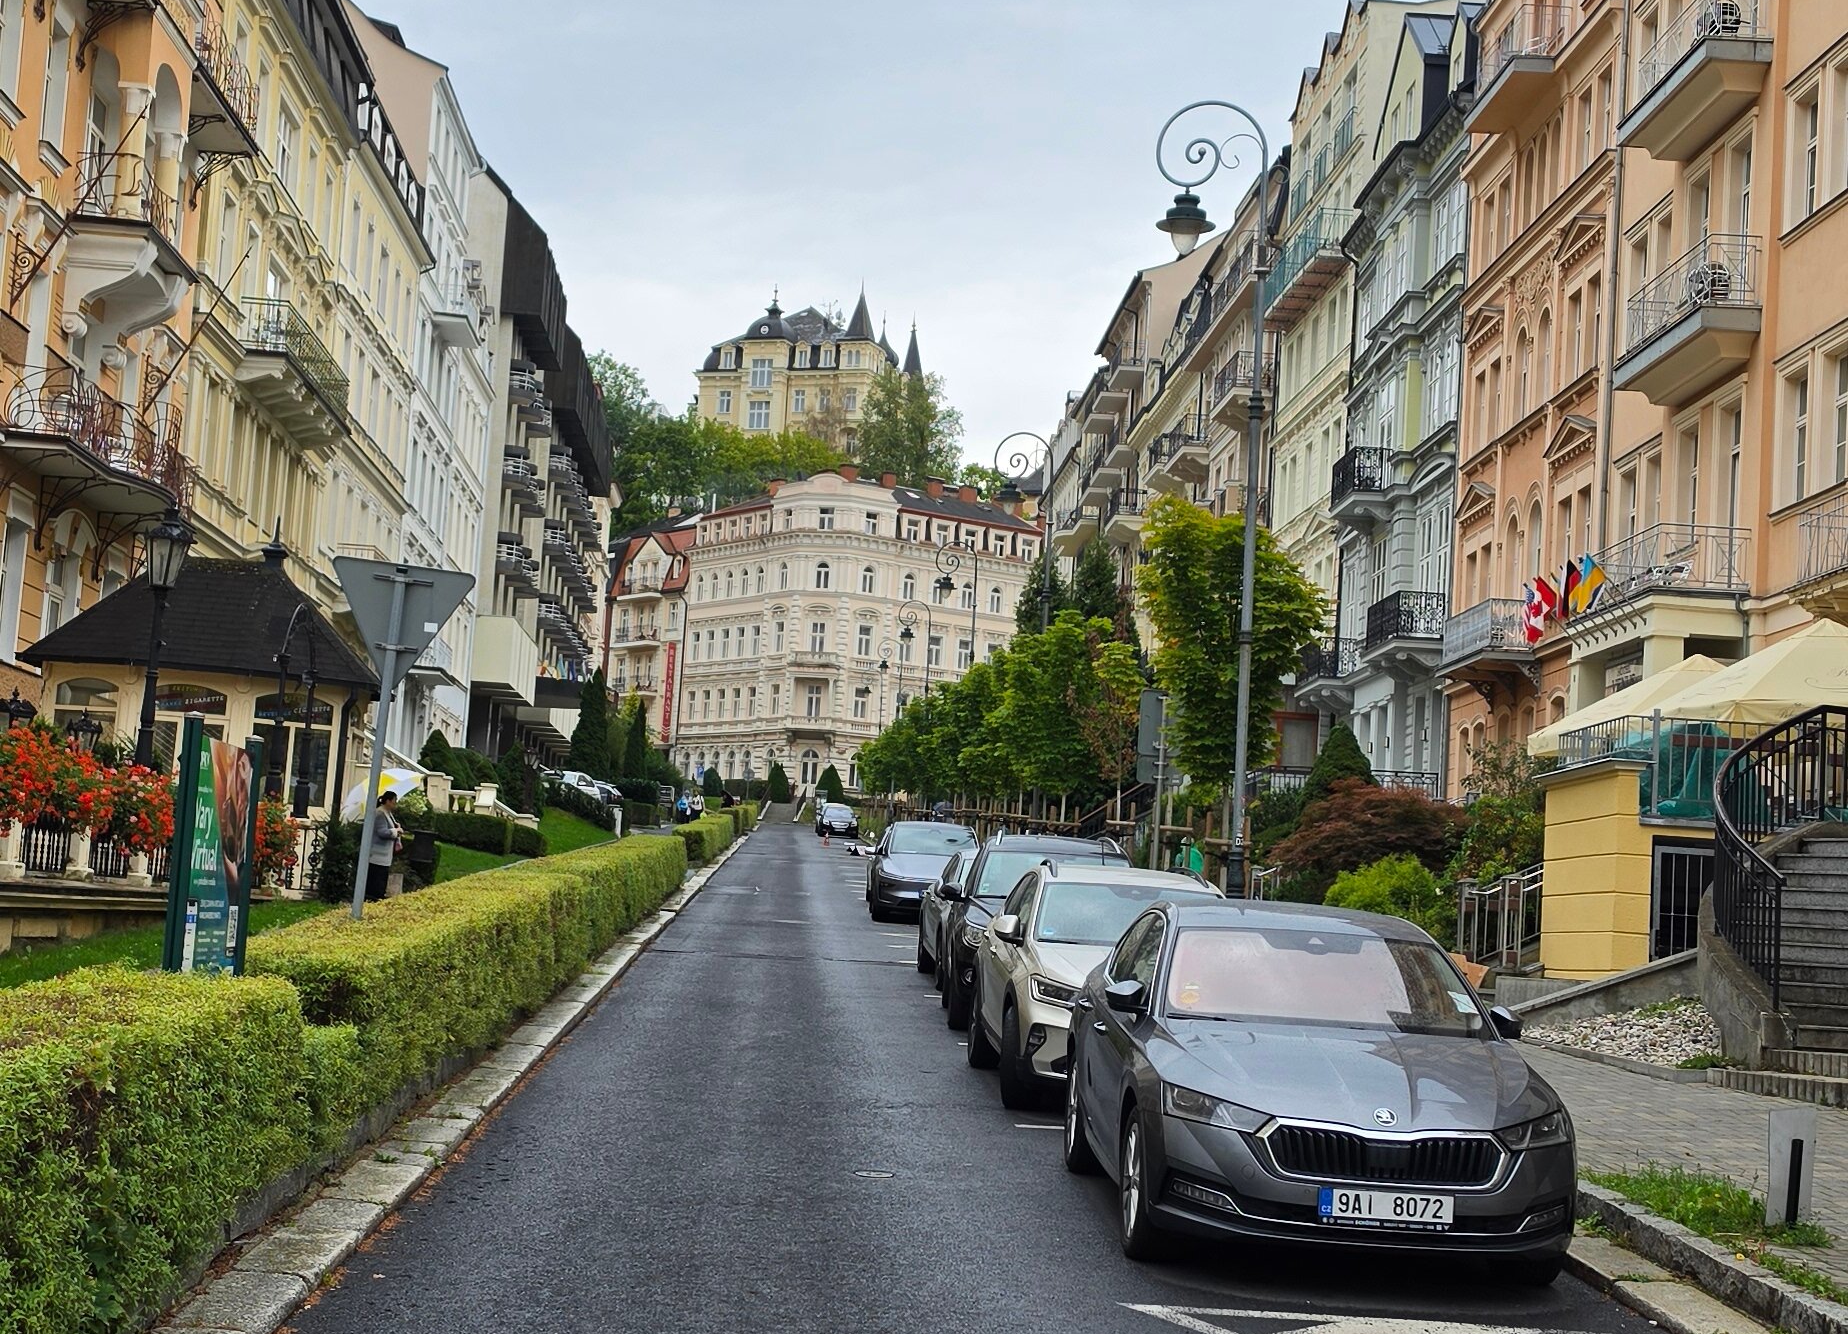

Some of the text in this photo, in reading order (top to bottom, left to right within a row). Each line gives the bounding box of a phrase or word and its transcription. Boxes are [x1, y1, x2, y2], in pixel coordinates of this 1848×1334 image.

[664, 648, 675, 720] RESTAURANT
[195, 797, 214, 839] Vary
[1321, 1205, 1332, 1213] CZ
[1392, 1196, 1445, 1220] 8072
